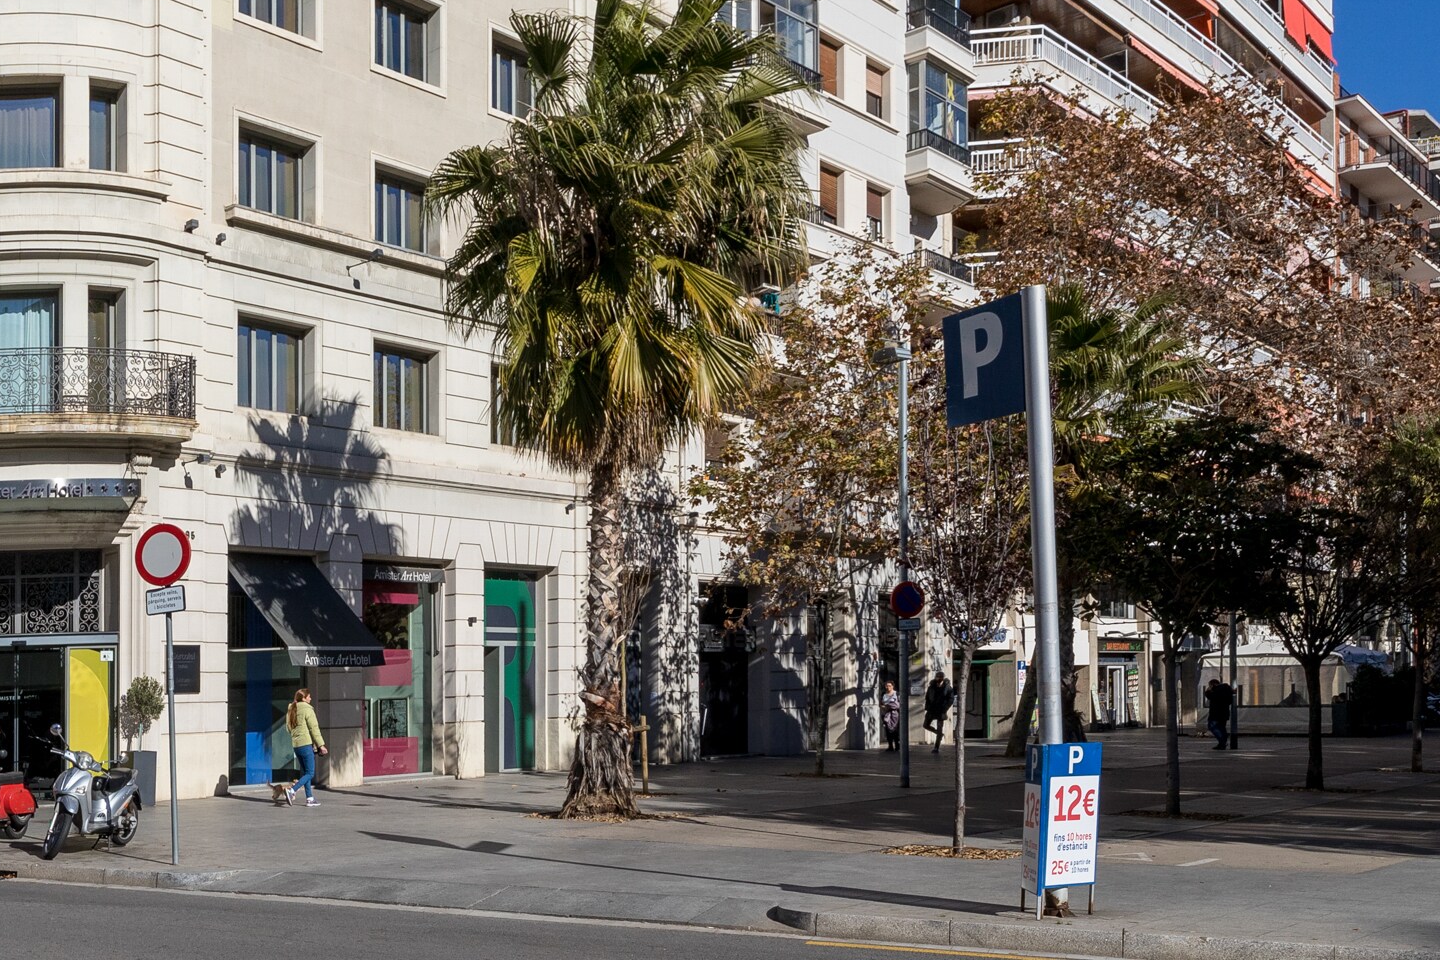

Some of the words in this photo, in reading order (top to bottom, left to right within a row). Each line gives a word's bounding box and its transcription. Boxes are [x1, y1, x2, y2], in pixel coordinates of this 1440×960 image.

[959, 311, 1004, 400] P
[47, 482, 84, 498] Hotel
[400, 570, 413, 581] Art
[413, 571, 432, 582] Hotel
[335, 654, 349, 665] Art
[349, 654, 371, 665] Hotel
[1030, 747, 1038, 781] P
[1068, 745, 1084, 774] P
[1054, 784, 1096, 822] 12€
[1053, 833, 1066, 842] fins
[1067, 832, 1075, 842] 10
[1075, 832, 1092, 841] hores
[1051, 860, 1069, 875] 25€
